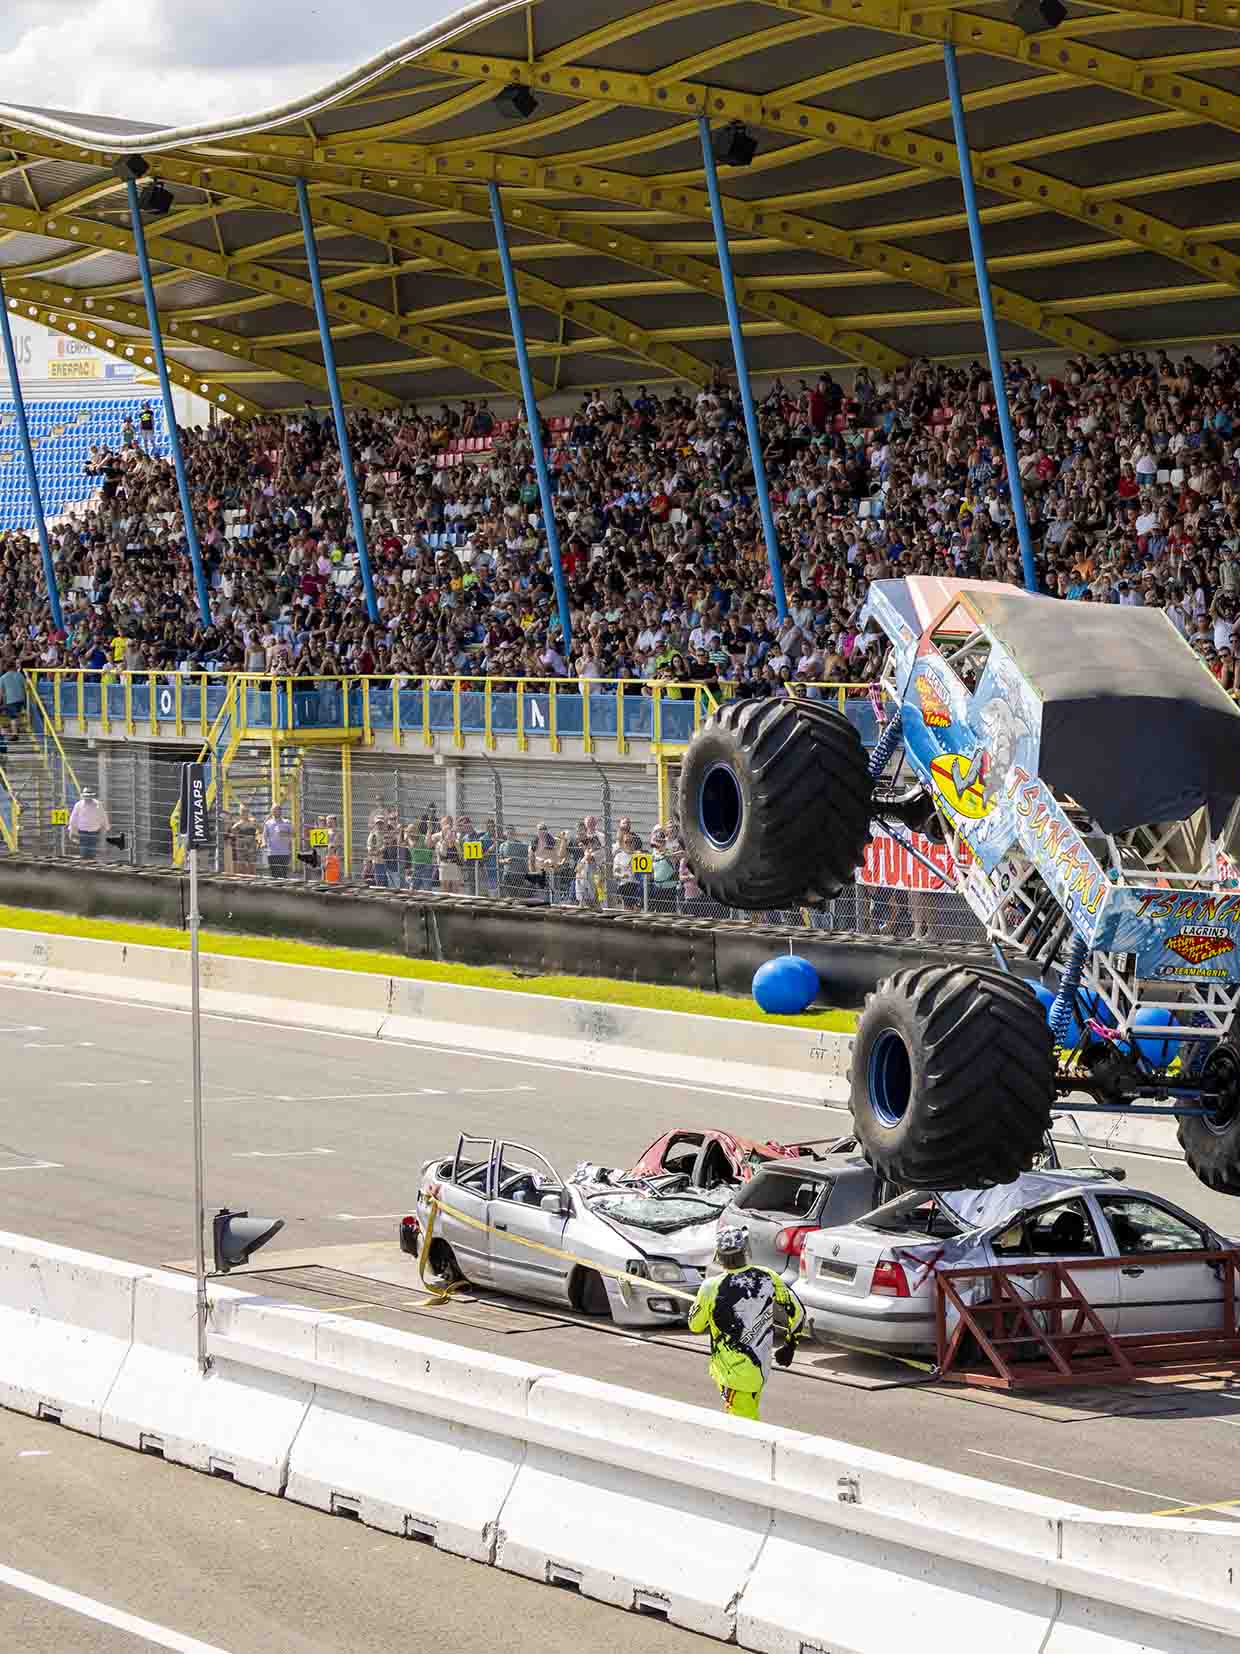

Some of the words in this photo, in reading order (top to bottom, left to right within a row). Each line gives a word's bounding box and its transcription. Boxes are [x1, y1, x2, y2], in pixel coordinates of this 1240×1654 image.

[193, 779, 205, 838] MYLAPS
[312, 831, 326, 845] 12
[1007, 766, 1106, 914] TSUNAMI
[467, 844, 478, 858] 11
[633, 856, 648, 871] 10
[1183, 926, 1225, 937] LAGRINS
